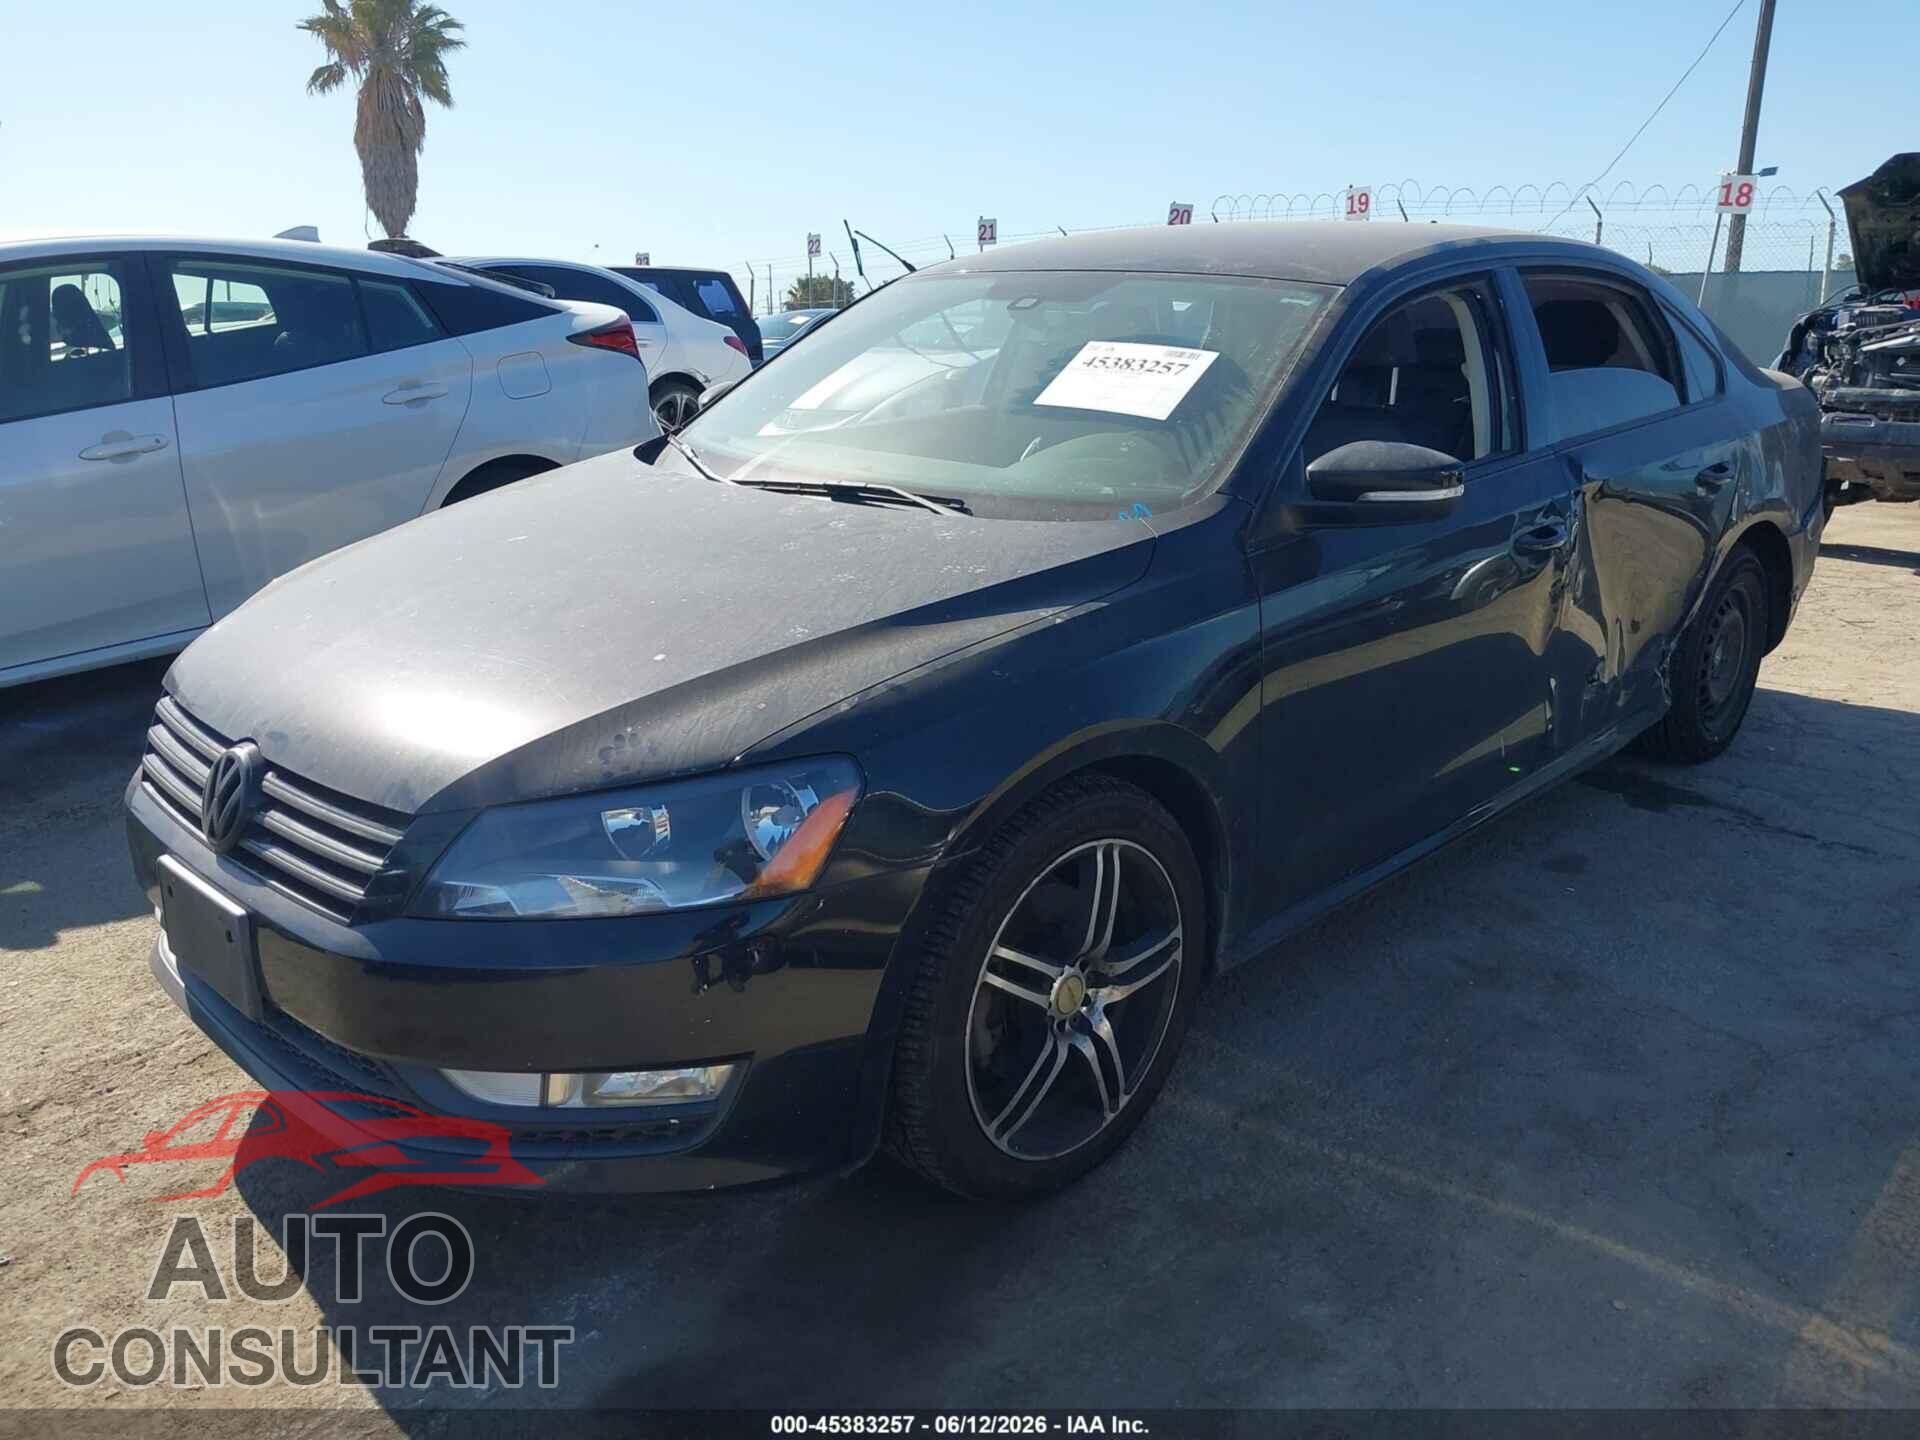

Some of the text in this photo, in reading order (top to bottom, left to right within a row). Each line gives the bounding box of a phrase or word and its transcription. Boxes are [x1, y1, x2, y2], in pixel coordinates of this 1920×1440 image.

[1346, 193, 1369, 215] 19
[1718, 182, 1753, 207] 18
[1168, 208, 1191, 225] 20
[979, 224, 995, 241] 21
[808, 239, 821, 254] 22
[1082, 355, 1191, 376] 45383257
